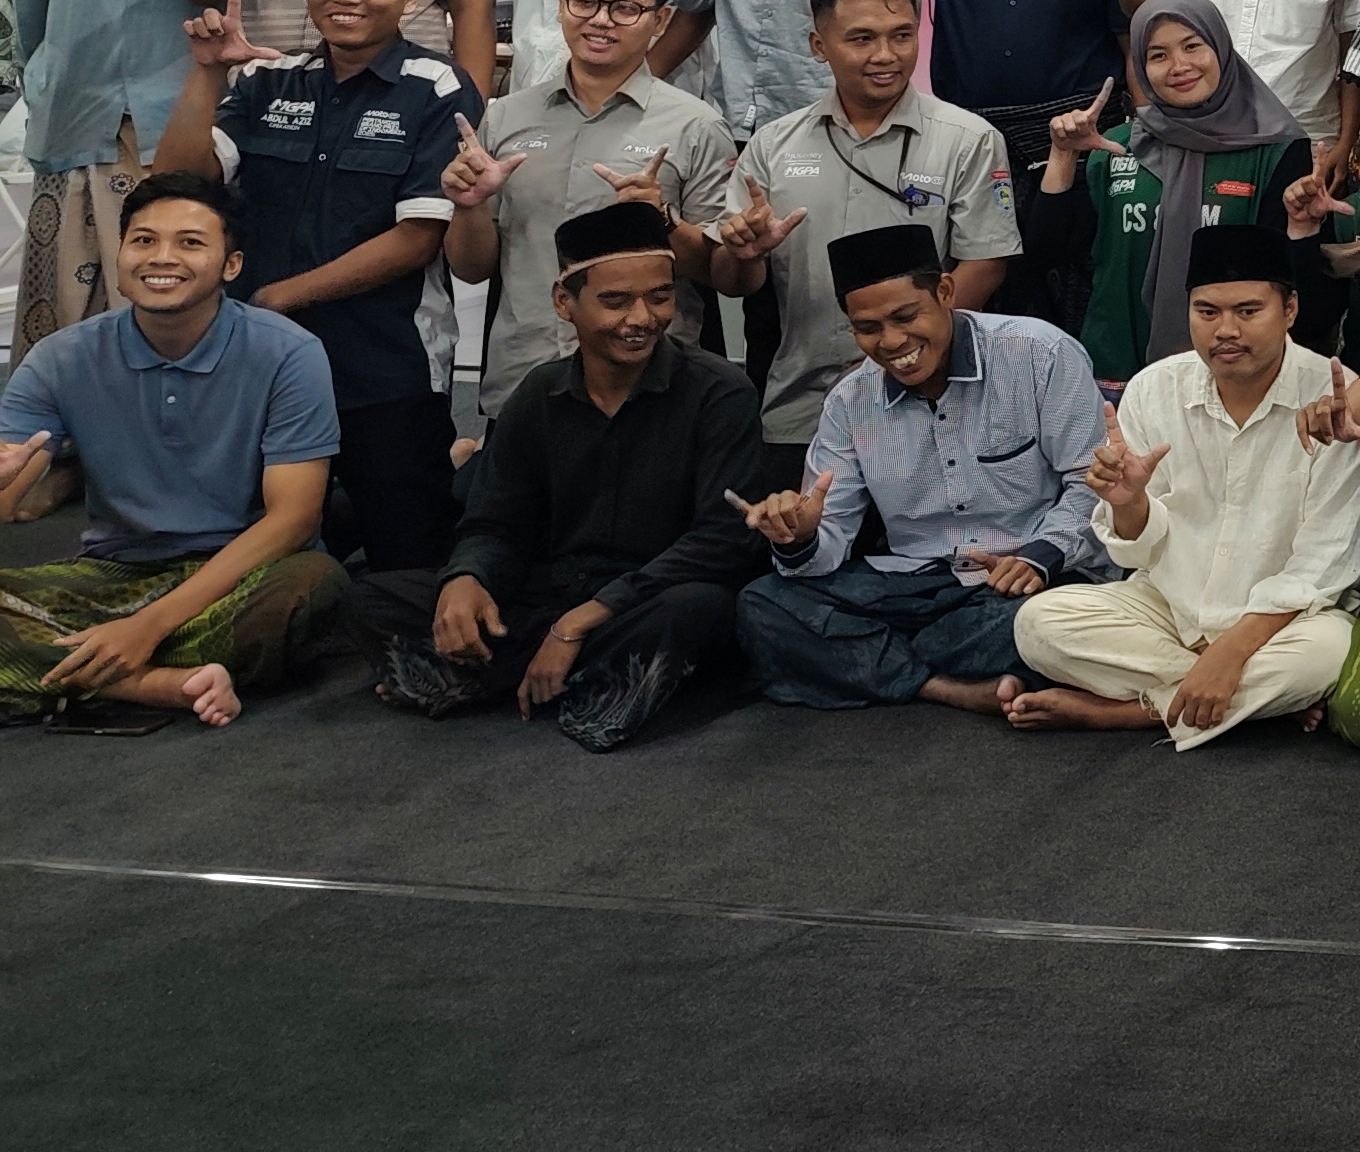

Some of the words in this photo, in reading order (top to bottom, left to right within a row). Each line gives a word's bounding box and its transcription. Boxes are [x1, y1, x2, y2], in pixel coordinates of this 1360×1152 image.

[260, 113, 289, 125] ABDUL
[292, 116, 313, 126] AZIZ
[1122, 202, 1147, 233] CS
